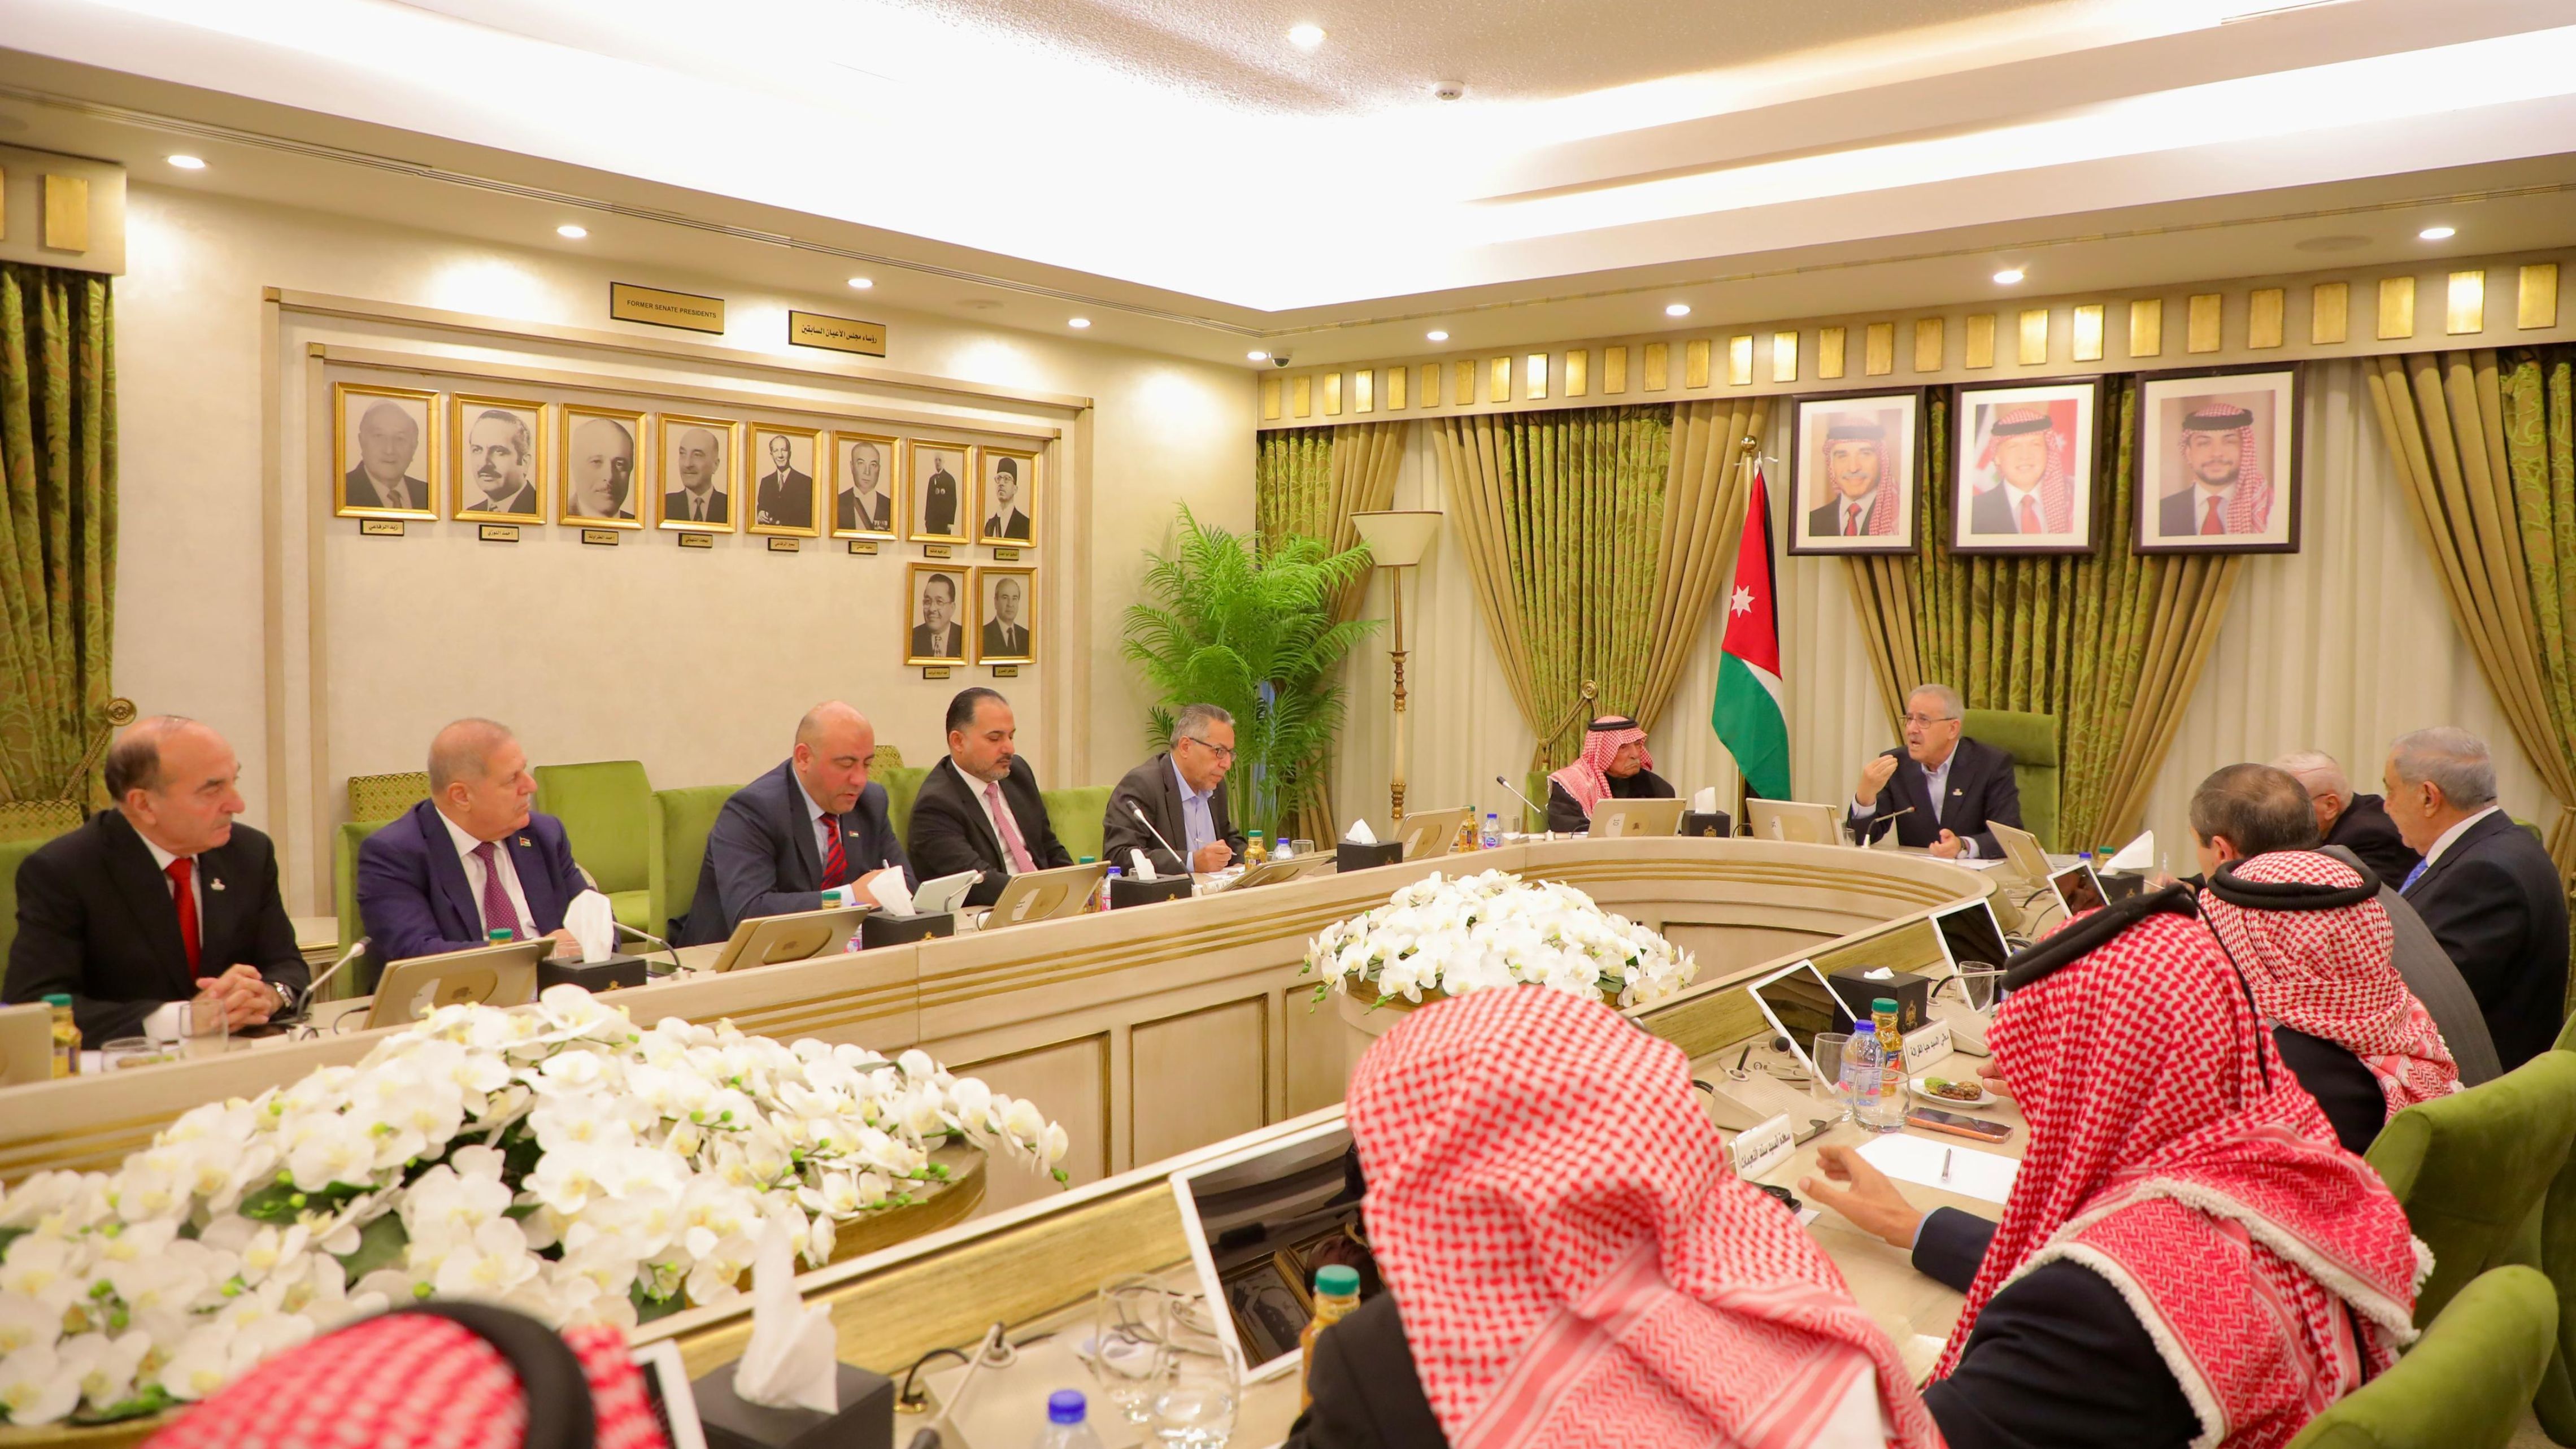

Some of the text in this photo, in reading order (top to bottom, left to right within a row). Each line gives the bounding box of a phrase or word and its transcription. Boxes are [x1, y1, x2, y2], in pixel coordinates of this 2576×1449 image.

[627, 299, 716, 318] FORMER SENATE PRESIDENTS
[801, 324, 825, 335] السابقين
[846, 332, 861, 341] مجلس
[863, 334, 877, 343] رؤساء
[1931, 1036, 1939, 1050] السيد
[1769, 1134, 1779, 1156] السيد
[1779, 1131, 1791, 1145] سعادة
